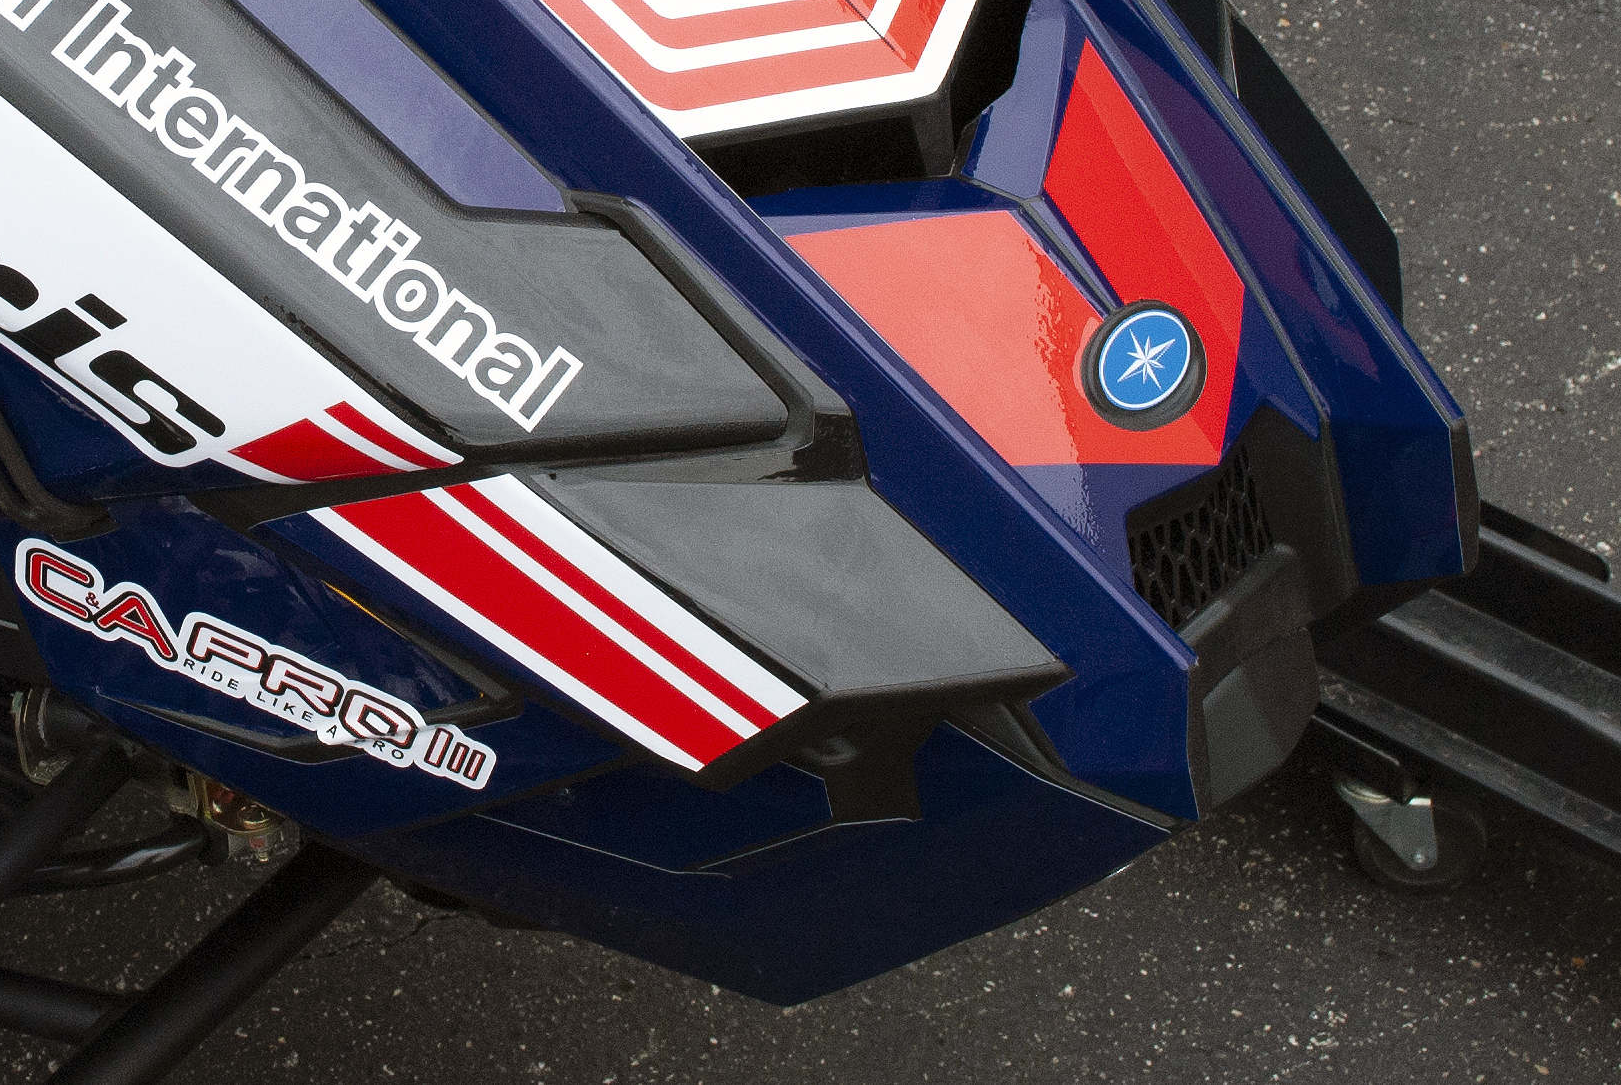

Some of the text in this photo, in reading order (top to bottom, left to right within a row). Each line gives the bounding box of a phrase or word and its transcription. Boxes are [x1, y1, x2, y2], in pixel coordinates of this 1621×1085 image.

[183, 659, 404, 761] RIDE LIKE A RO
[186, 621, 418, 750] PRO
